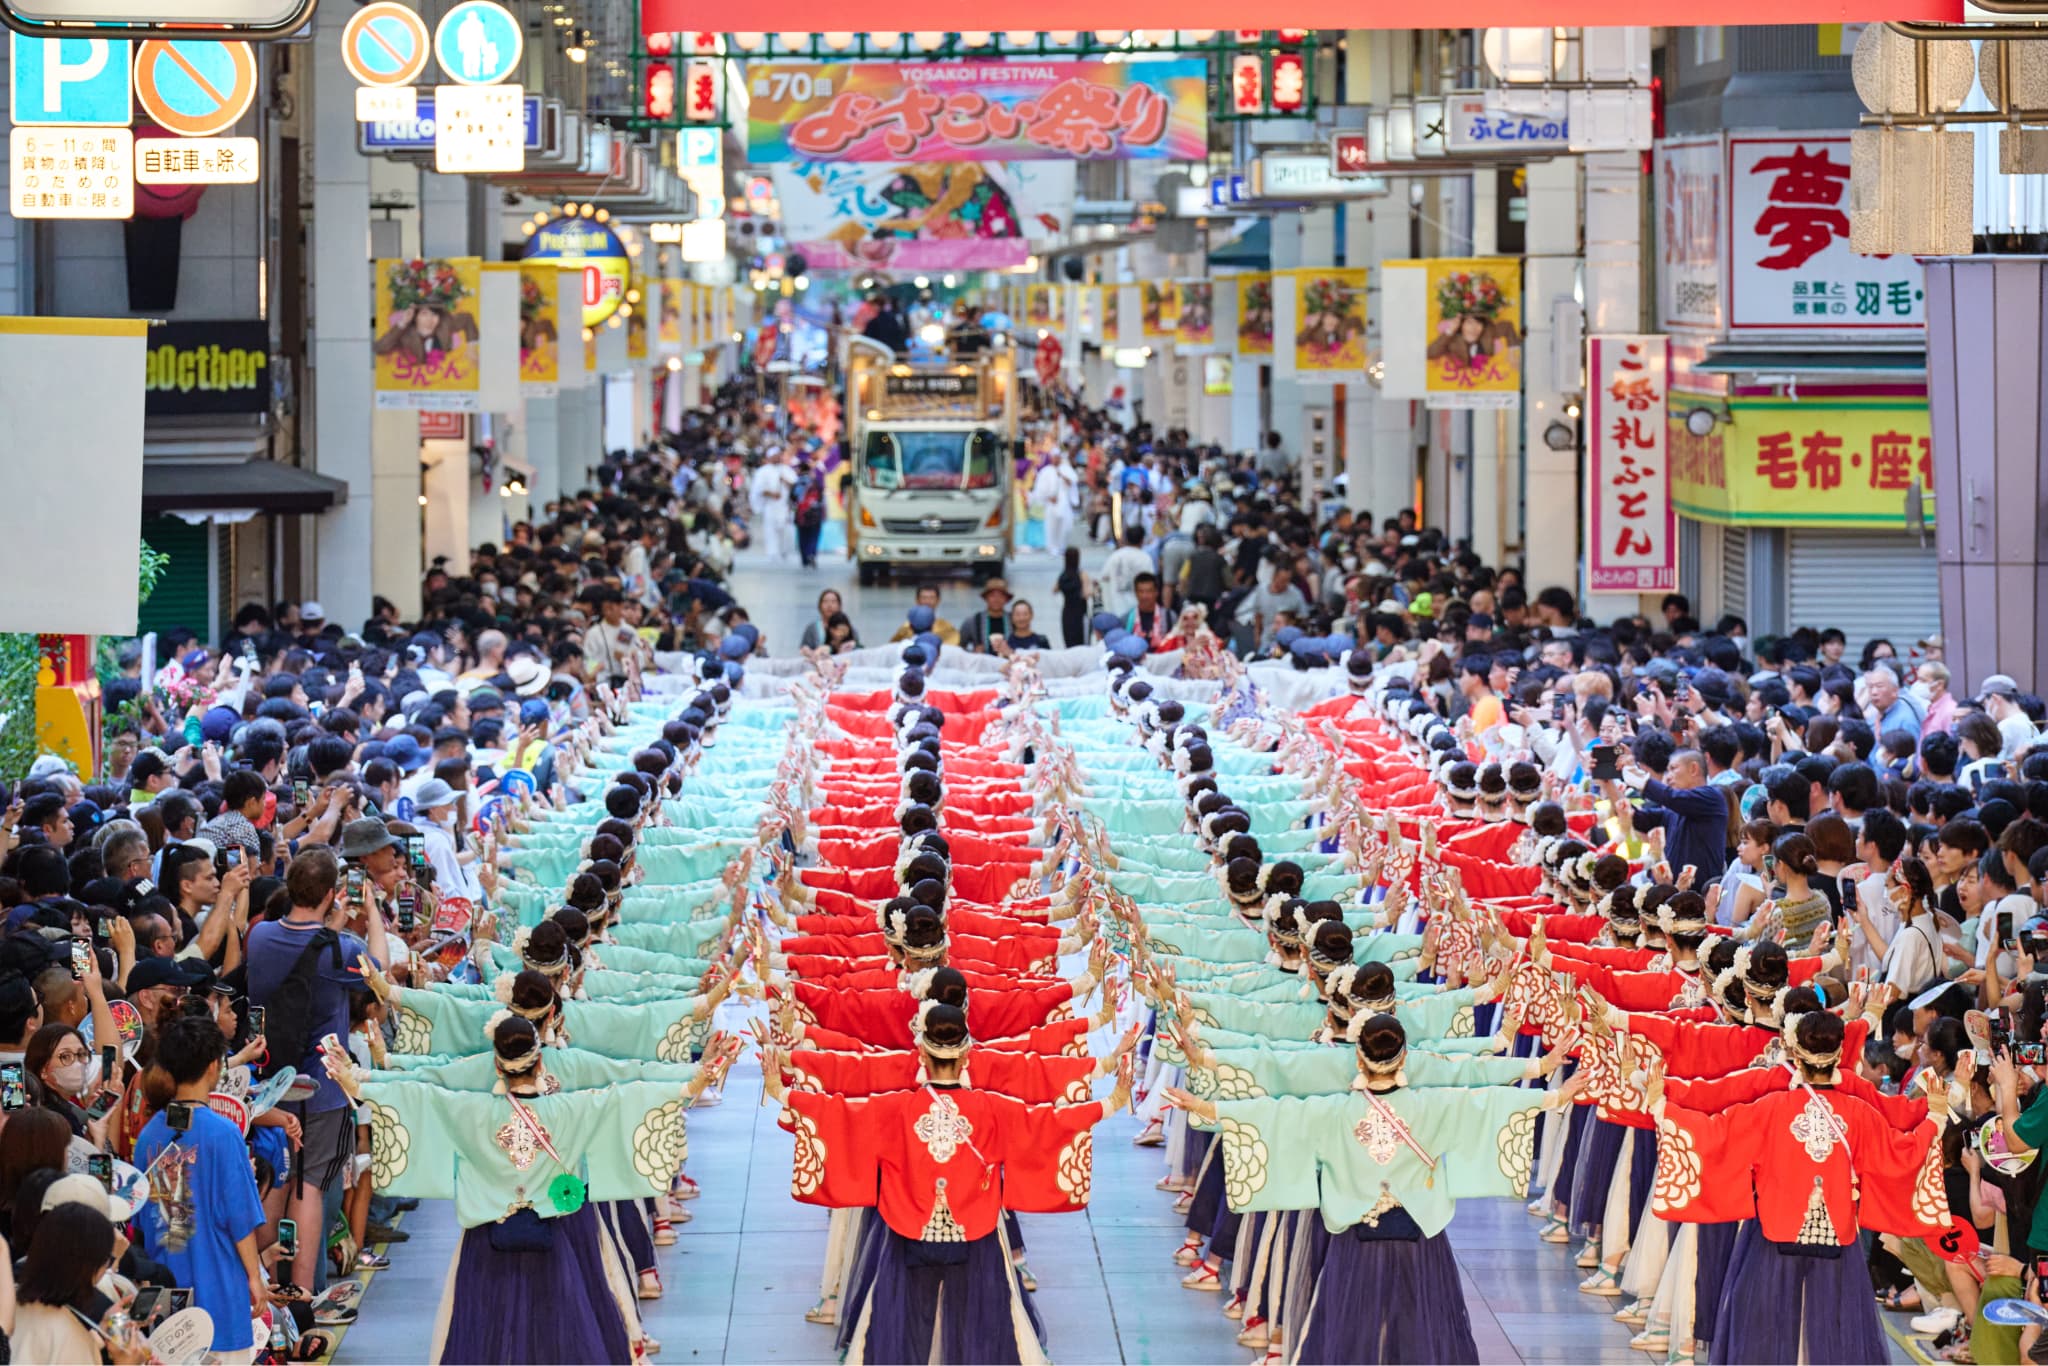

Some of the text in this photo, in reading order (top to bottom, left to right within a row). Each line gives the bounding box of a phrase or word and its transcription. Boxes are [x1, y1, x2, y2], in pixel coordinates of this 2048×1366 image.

[43, 38, 109, 112] P
[901, 67, 1058, 81] YOSAKOI FESTIVAL
[791, 79, 1169, 155] よさこい祭り
[145, 149, 248, 173] 自転車を除く
[1606, 344, 1661, 557] ご婚礼ふとん
